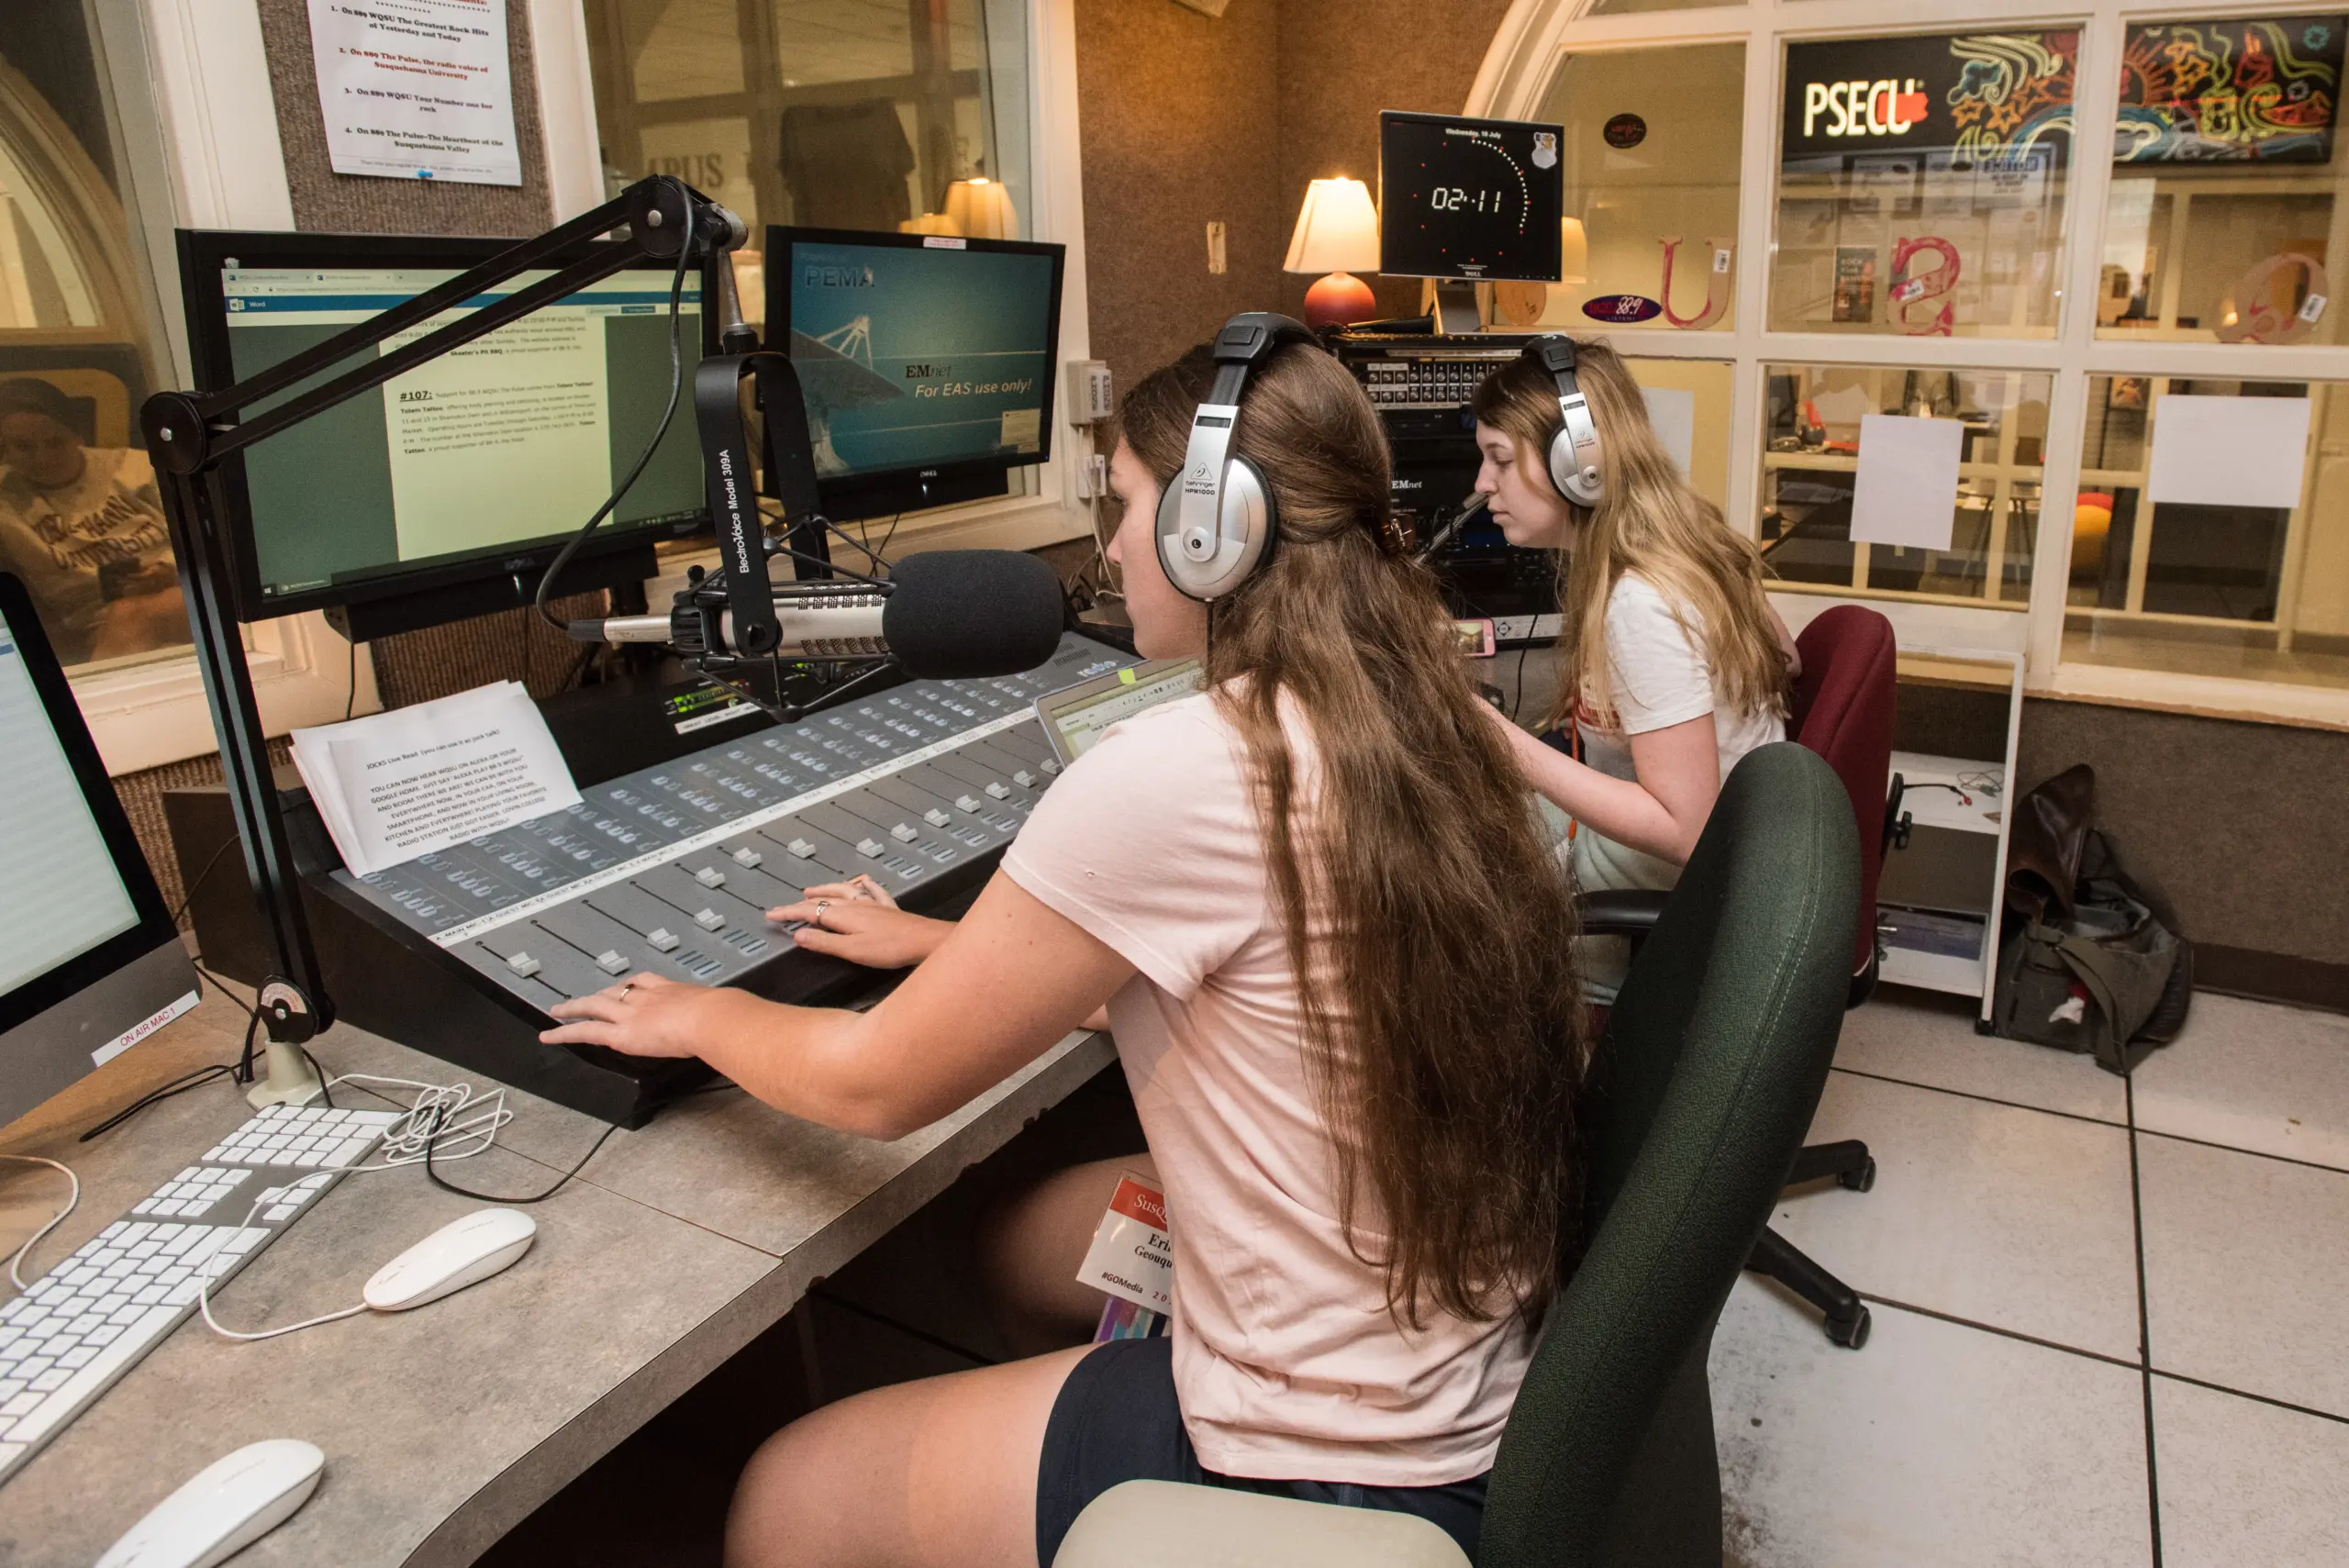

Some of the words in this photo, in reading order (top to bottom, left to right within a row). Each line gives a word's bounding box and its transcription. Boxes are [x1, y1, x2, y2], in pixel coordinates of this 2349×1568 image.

[369, 12, 395, 22] WQSU
[397, 17, 412, 25] The
[414, 19, 447, 30] Greatest
[449, 26, 471, 34] Rock
[472, 28, 489, 37] Hits
[379, 24, 420, 37] Yesterday
[421, 30, 436, 39] and
[438, 32, 462, 43] Today
[373, 61, 427, 75] Susquehanna
[429, 68, 468, 81] University
[380, 52, 396, 61] The
[397, 55, 422, 64] Pulse,
[422, 58, 436, 66] the
[437, 61, 457, 69] radio
[457, 63, 479, 72] voice
[386, 92, 412, 101] WQSU
[414, 95, 432, 103] Your
[433, 97, 464, 106] Number
[1804, 79, 1916, 137] PSECU
[356, 127, 369, 135] On
[385, 129, 401, 138] The
[442, 136, 480, 145] Heartbeat
[1489, 130, 1501, 139] July
[394, 140, 445, 151] Susquehanna
[447, 144, 471, 153] Valley
[1431, 187, 1502, 214] 02:11
[805, 266, 875, 287] PEMA
[249, 300, 266, 308] Word
[1616, 296, 1644, 315] 88.9
[905, 364, 952, 378] EMnet
[400, 391, 433, 402] #107:
[915, 384, 939, 398] For
[942, 382, 971, 396] EAS
[974, 383, 998, 394] use
[1001, 378, 1032, 395] only!
[719, 449, 734, 478] 309A
[726, 478, 740, 510] Model
[1186, 480, 1216, 488] behringer
[1391, 480, 1422, 489] EMnet
[367, 760, 387, 770] JOCKS
[402, 751, 419, 760] Read
[371, 785, 385, 794] YOU
[385, 782, 400, 790] CAN
[401, 776, 418, 785] NOW
[419, 771, 438, 780] HEAR
[438, 765, 457, 774] WQSU
[470, 757, 488, 765] ALEXA
[499, 748, 517, 757] YOUR
[371, 793, 398, 804] GOOGLE
[423, 781, 438, 789] JUST
[473, 766, 488, 774] PLAY
[377, 805, 393, 813] AND
[393, 798, 416, 808] BOOM
[416, 792, 436, 801] THERE
[497, 769, 514, 777] WITH
[514, 764, 528, 773] YOU
[391, 801, 436, 819] EVERYWHERE
[463, 788, 481, 797] YOUR
[507, 774, 524, 784] YOUR
[437, 806, 451, 815] AND
[451, 802, 468, 810] NOW
[476, 793, 496, 802] YOUR
[495, 787, 516, 796] LIVING
[384, 829, 414, 842] KITCHEN
[415, 824, 429, 832] AND
[474, 801, 502, 812] PLAYING
[502, 795, 518, 804] YOUR
[518, 786, 548, 799] FAVORITE
[397, 837, 419, 848] RADIO
[421, 828, 449, 840] STATION
[449, 822, 464, 830] JUST
[464, 817, 478, 826] GOT
[450, 830, 471, 840] RADIO
[471, 824, 488, 834] WITH
[445, 928, 465, 937] MAIN
[120, 1033, 135, 1047] ON
[135, 1023, 150, 1039] AIR
[150, 1011, 171, 1028] MAC
[171, 1007, 175, 1016] 1
[1101, 1271, 1143, 1295] #GOMedia
